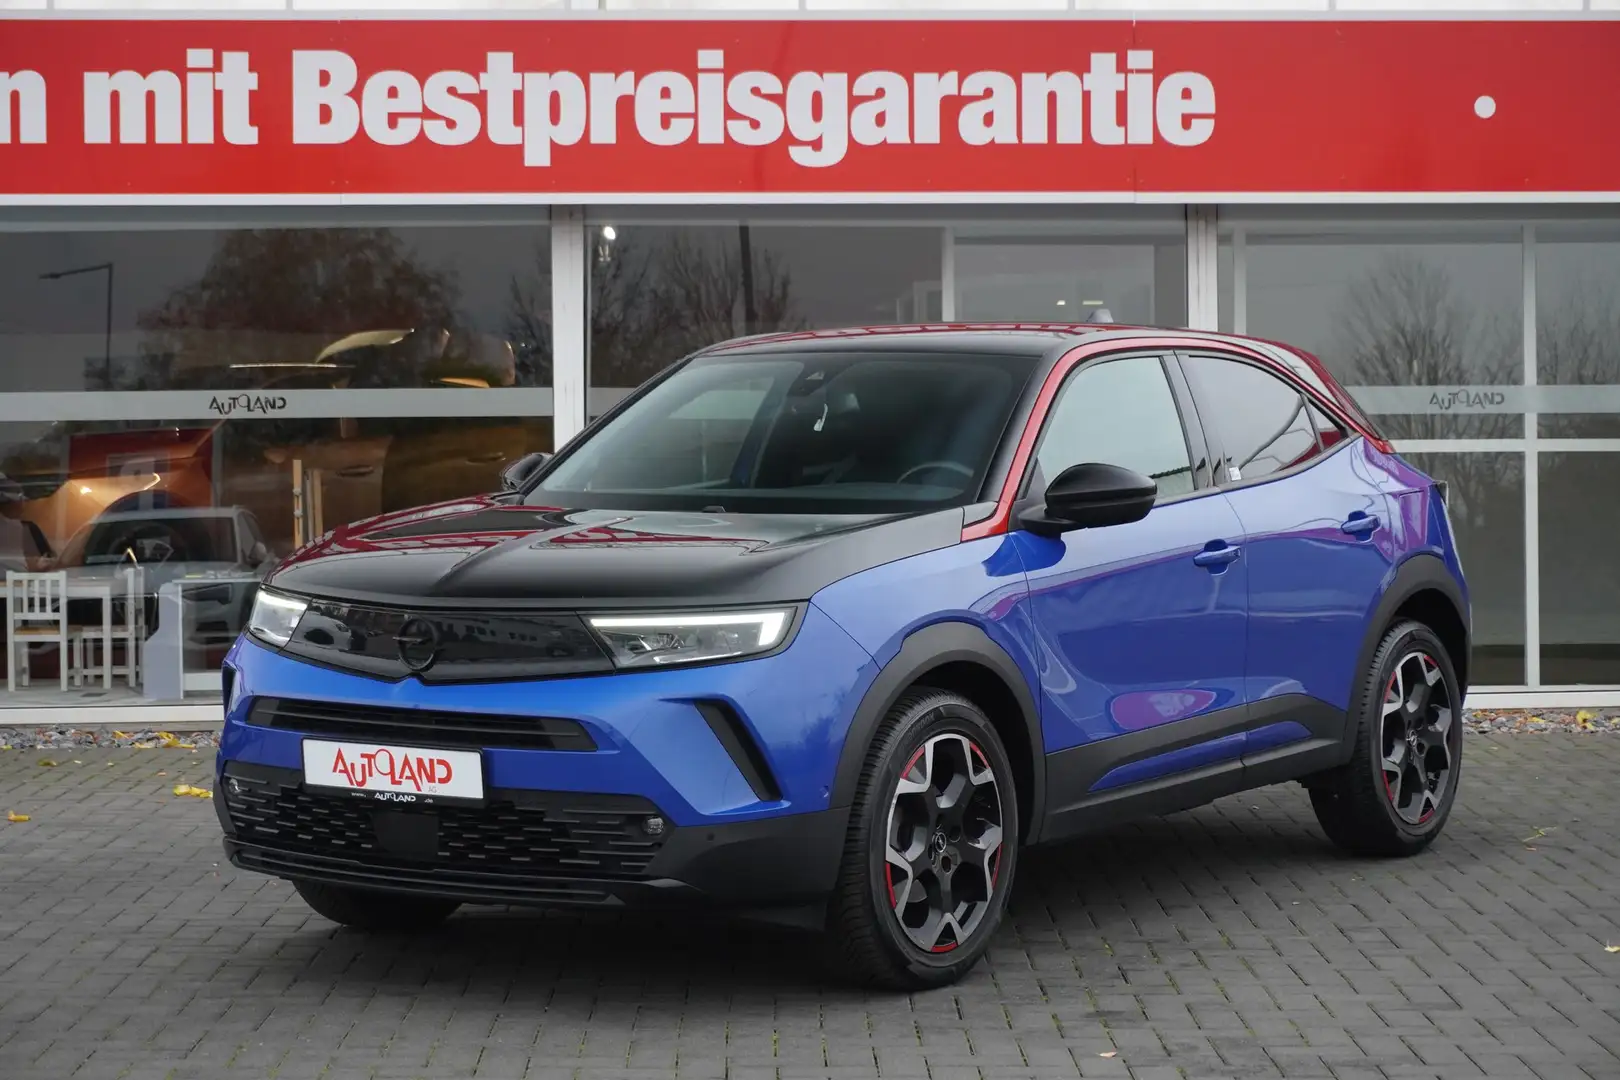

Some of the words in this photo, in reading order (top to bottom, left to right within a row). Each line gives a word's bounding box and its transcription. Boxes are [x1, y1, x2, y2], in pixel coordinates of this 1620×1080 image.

[83, 48, 259, 145] mit
[292, 48, 1216, 168] Bestpreisgarantie
[208, 393, 287, 415] AUTOLAND
[1429, 388, 1505, 410] AUTOLAND
[332, 747, 453, 792] AUTOLAND
[374, 792, 417, 803] AUTOLAND
